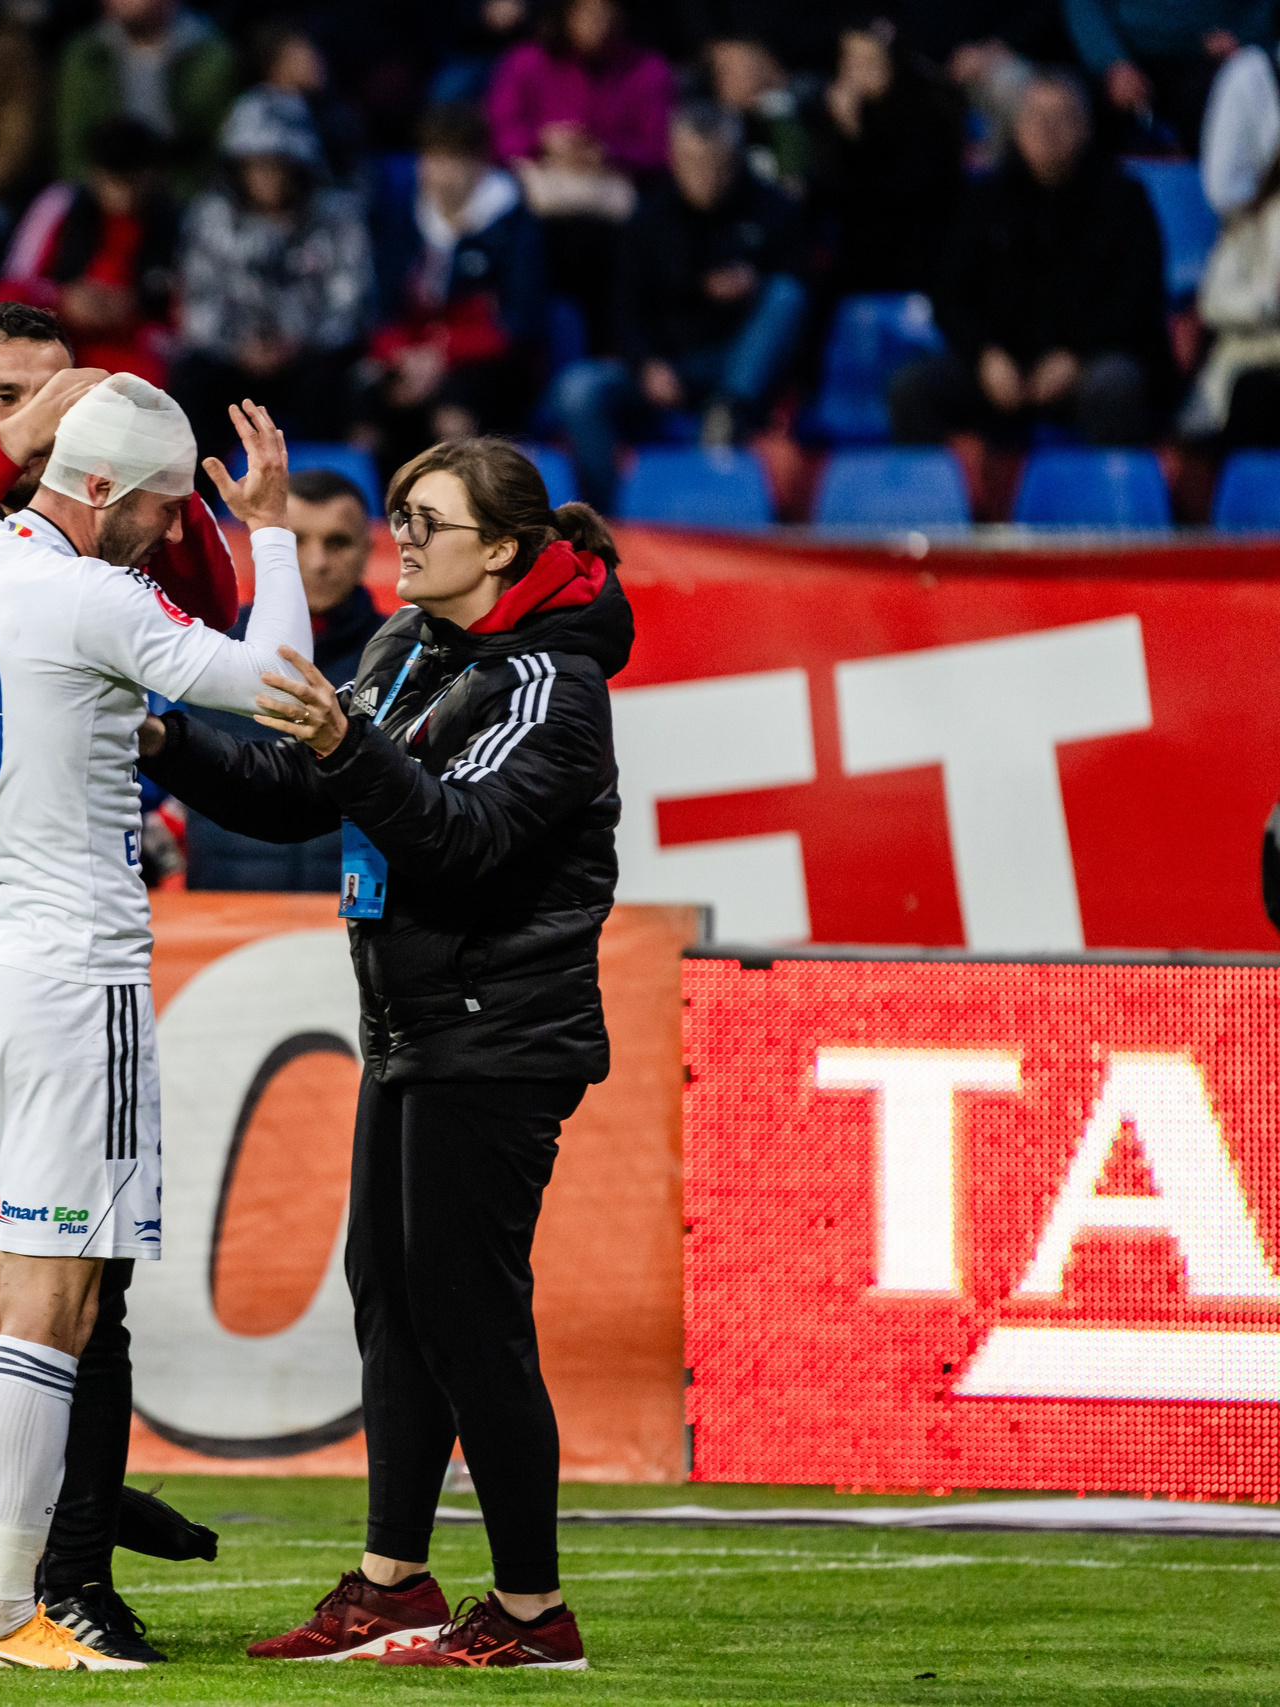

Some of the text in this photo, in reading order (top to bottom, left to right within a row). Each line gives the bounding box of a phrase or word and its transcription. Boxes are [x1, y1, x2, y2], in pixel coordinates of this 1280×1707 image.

[1, 1200, 89, 1222] Smart Eco
[58, 1222, 88, 1234] Plus
